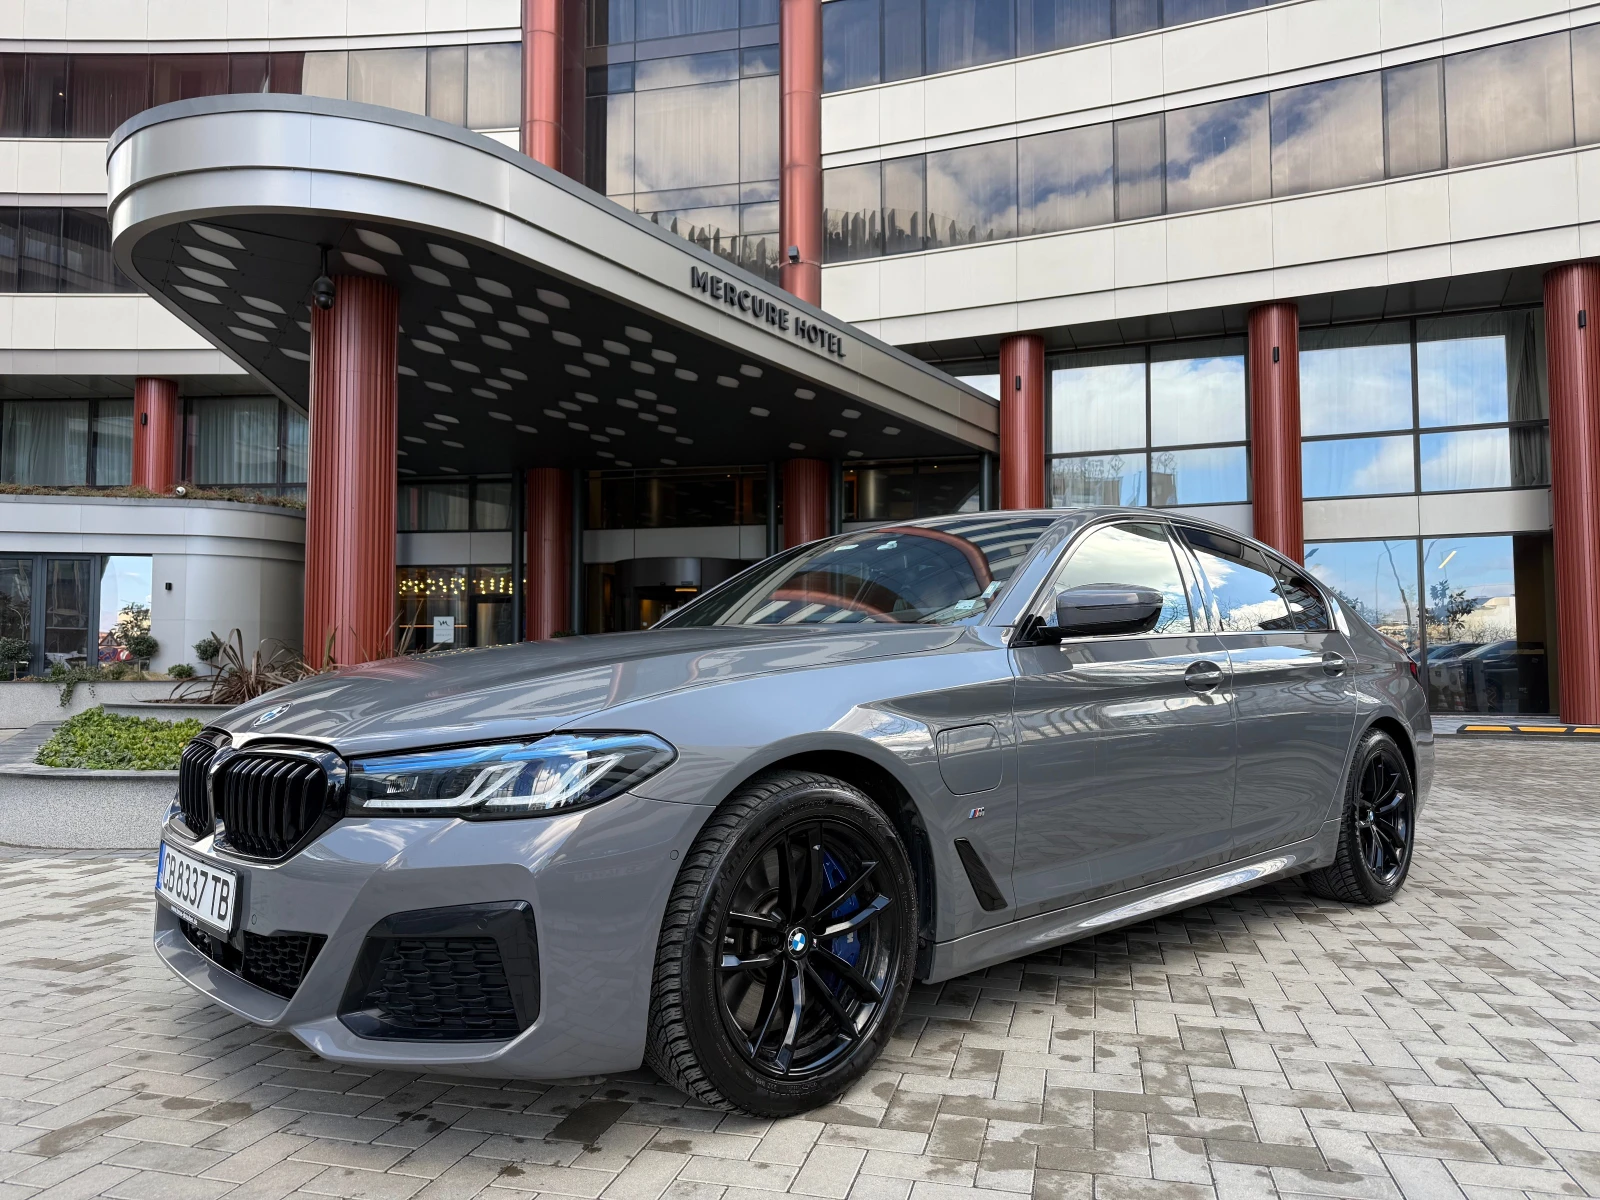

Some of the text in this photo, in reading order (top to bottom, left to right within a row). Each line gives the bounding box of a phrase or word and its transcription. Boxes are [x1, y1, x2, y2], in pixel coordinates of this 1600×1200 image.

[690, 265, 847, 358] MERCURE HOTEL
[162, 852, 177, 893] CB
[176, 860, 209, 909] 8337
[210, 874, 230, 921] TB
